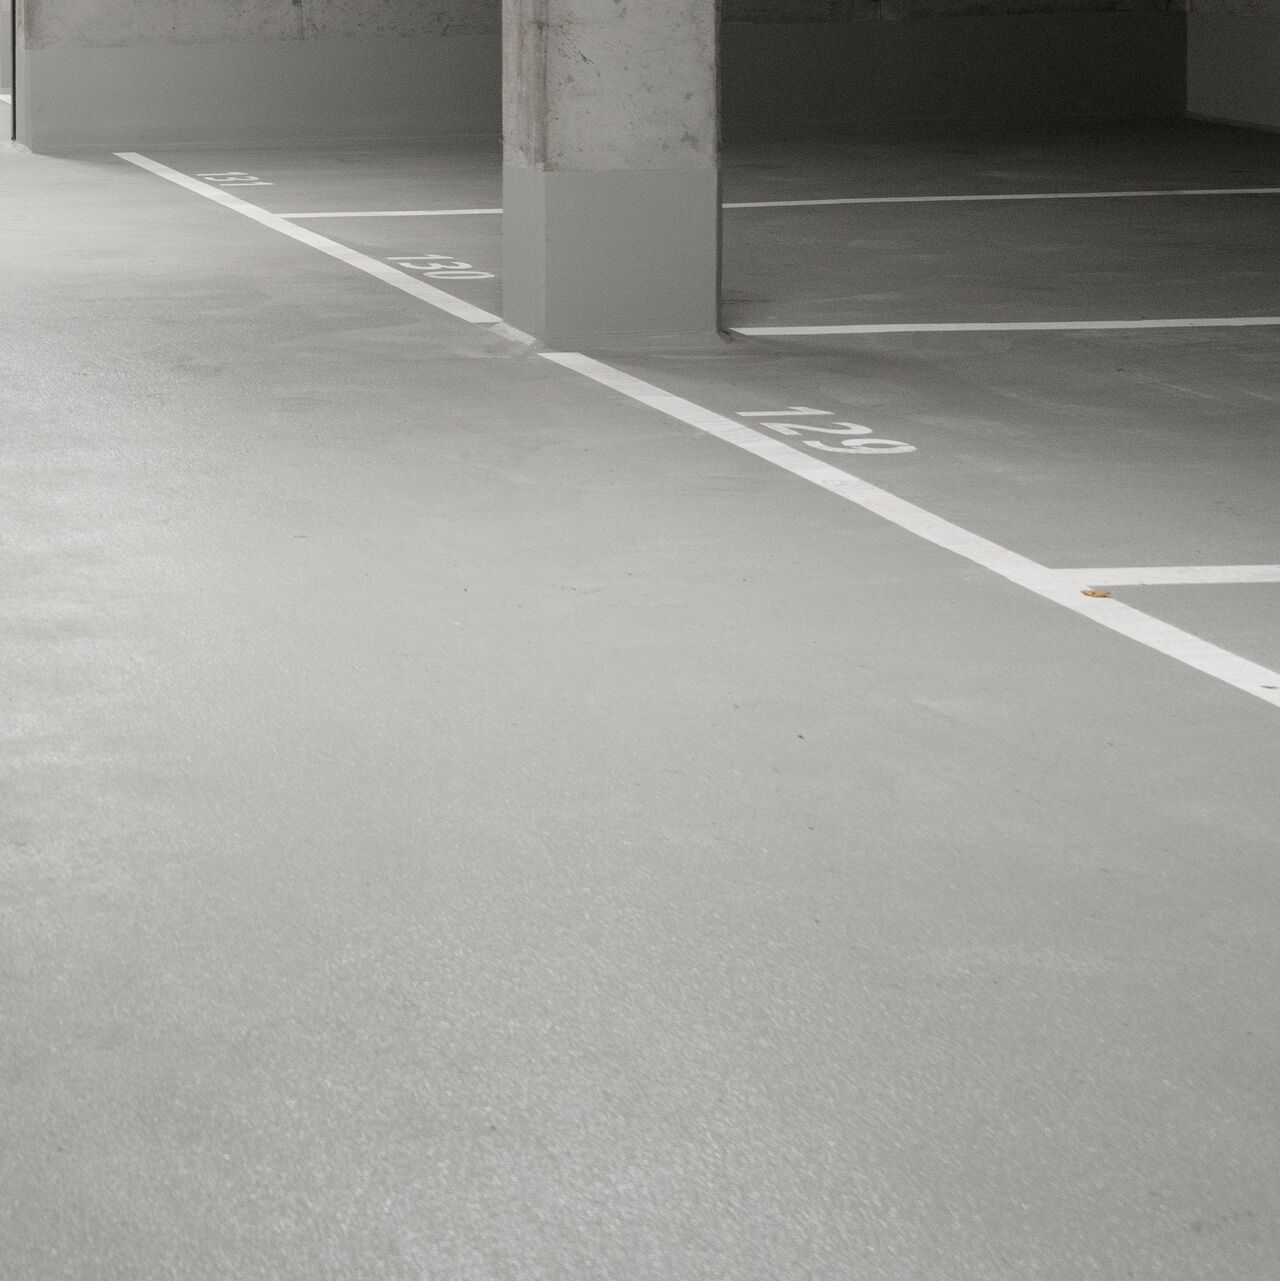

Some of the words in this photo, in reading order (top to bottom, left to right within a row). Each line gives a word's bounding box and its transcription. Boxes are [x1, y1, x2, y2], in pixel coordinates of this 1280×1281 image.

[195, 171, 274, 186] 131
[384, 254, 496, 280] 130
[735, 405, 918, 455] 129
